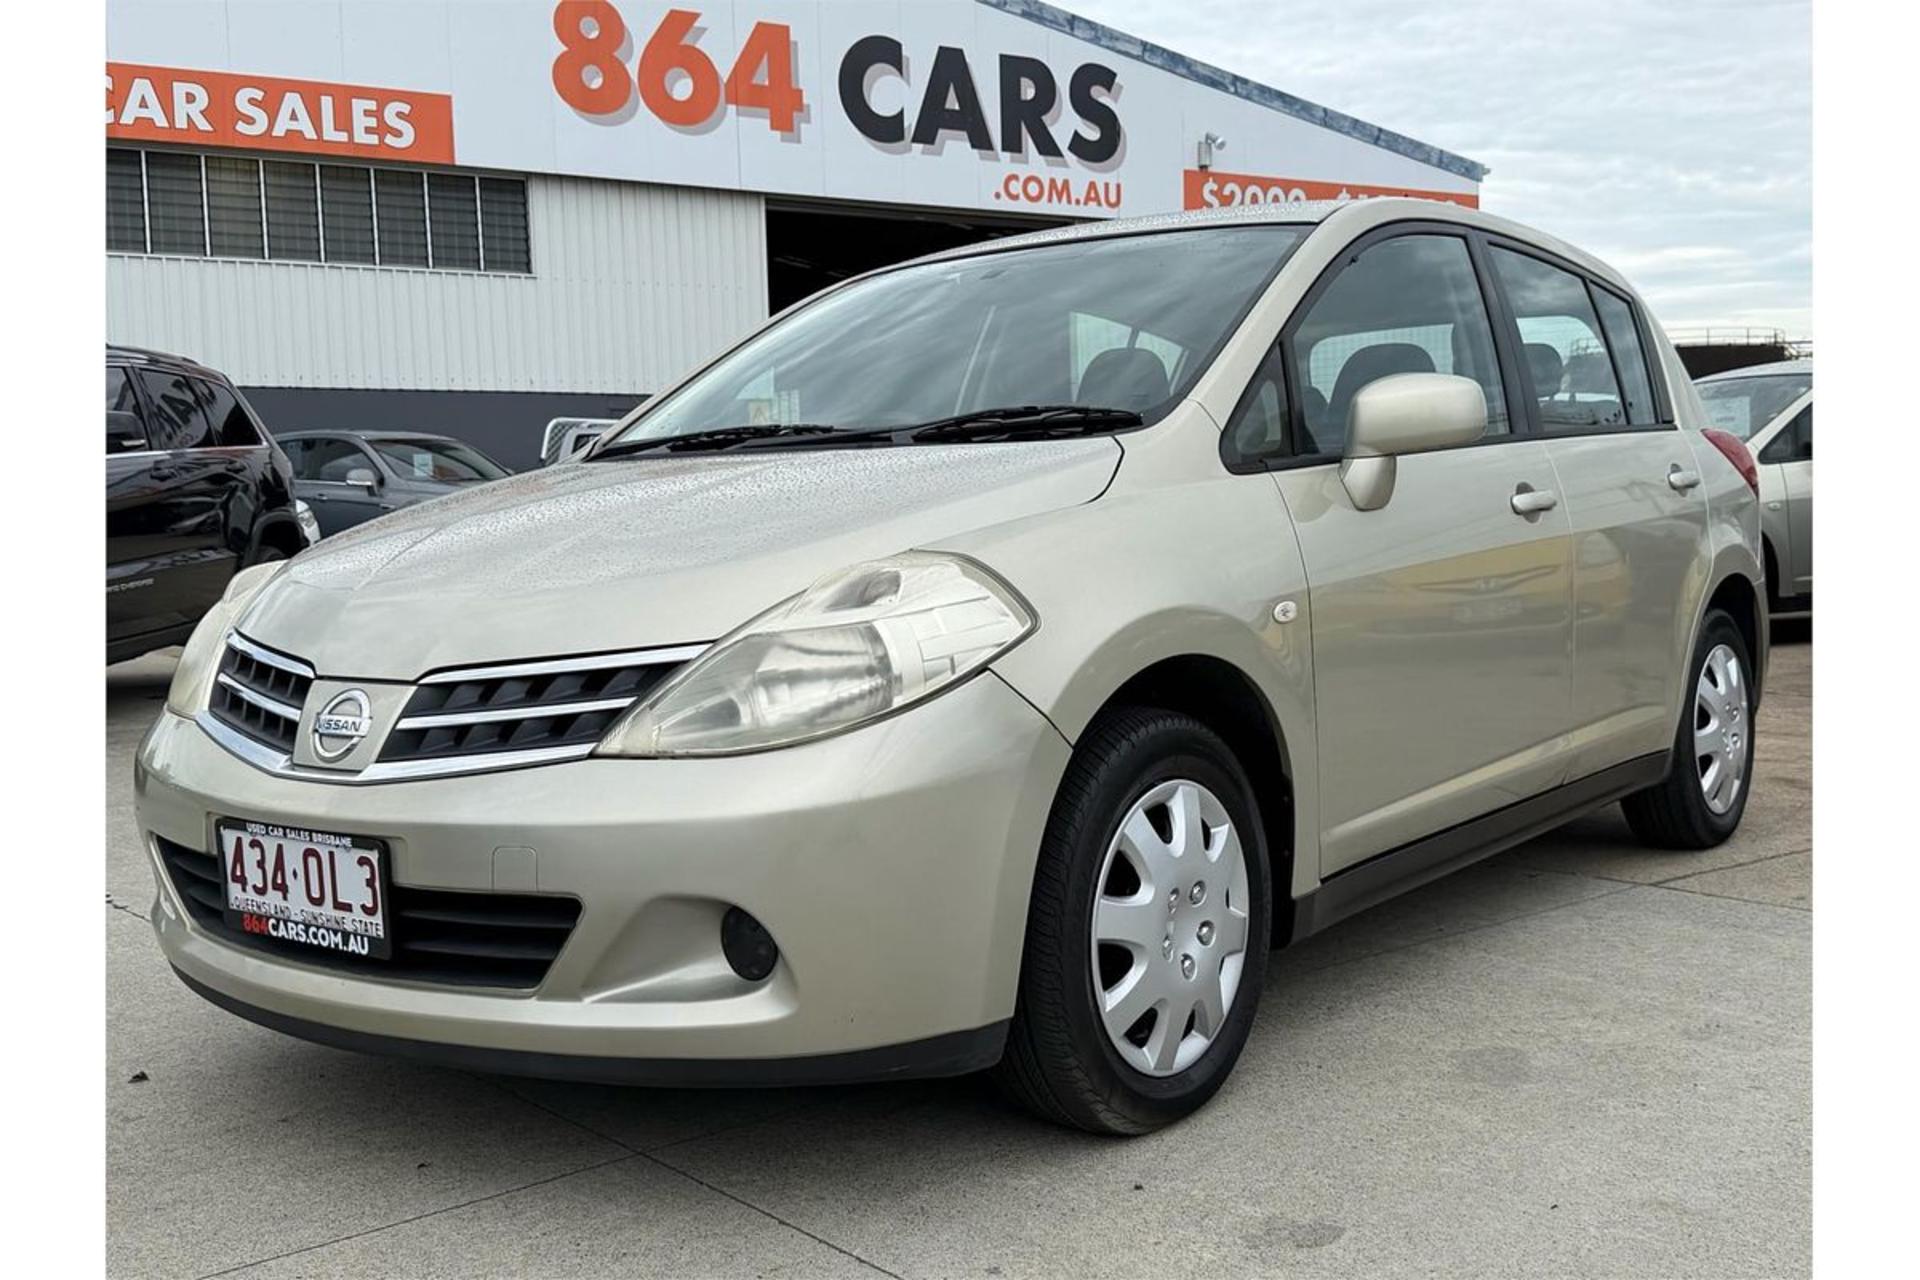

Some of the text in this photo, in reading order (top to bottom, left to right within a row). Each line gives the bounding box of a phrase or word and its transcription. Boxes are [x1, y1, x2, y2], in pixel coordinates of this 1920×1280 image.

[552, 0, 1121, 163] 864 CARS
[106, 74, 416, 149] AR SALES
[994, 173, 1121, 208] .COM.AU
[246, 822, 352, 847] USED CAR SALES BRISBANE
[232, 896, 291, 919] QUEENSLAND
[300, 909, 347, 930] SUNSHINE
[352, 918, 383, 937] STATE
[242, 913, 369, 955] 864CARS.COM.AU
